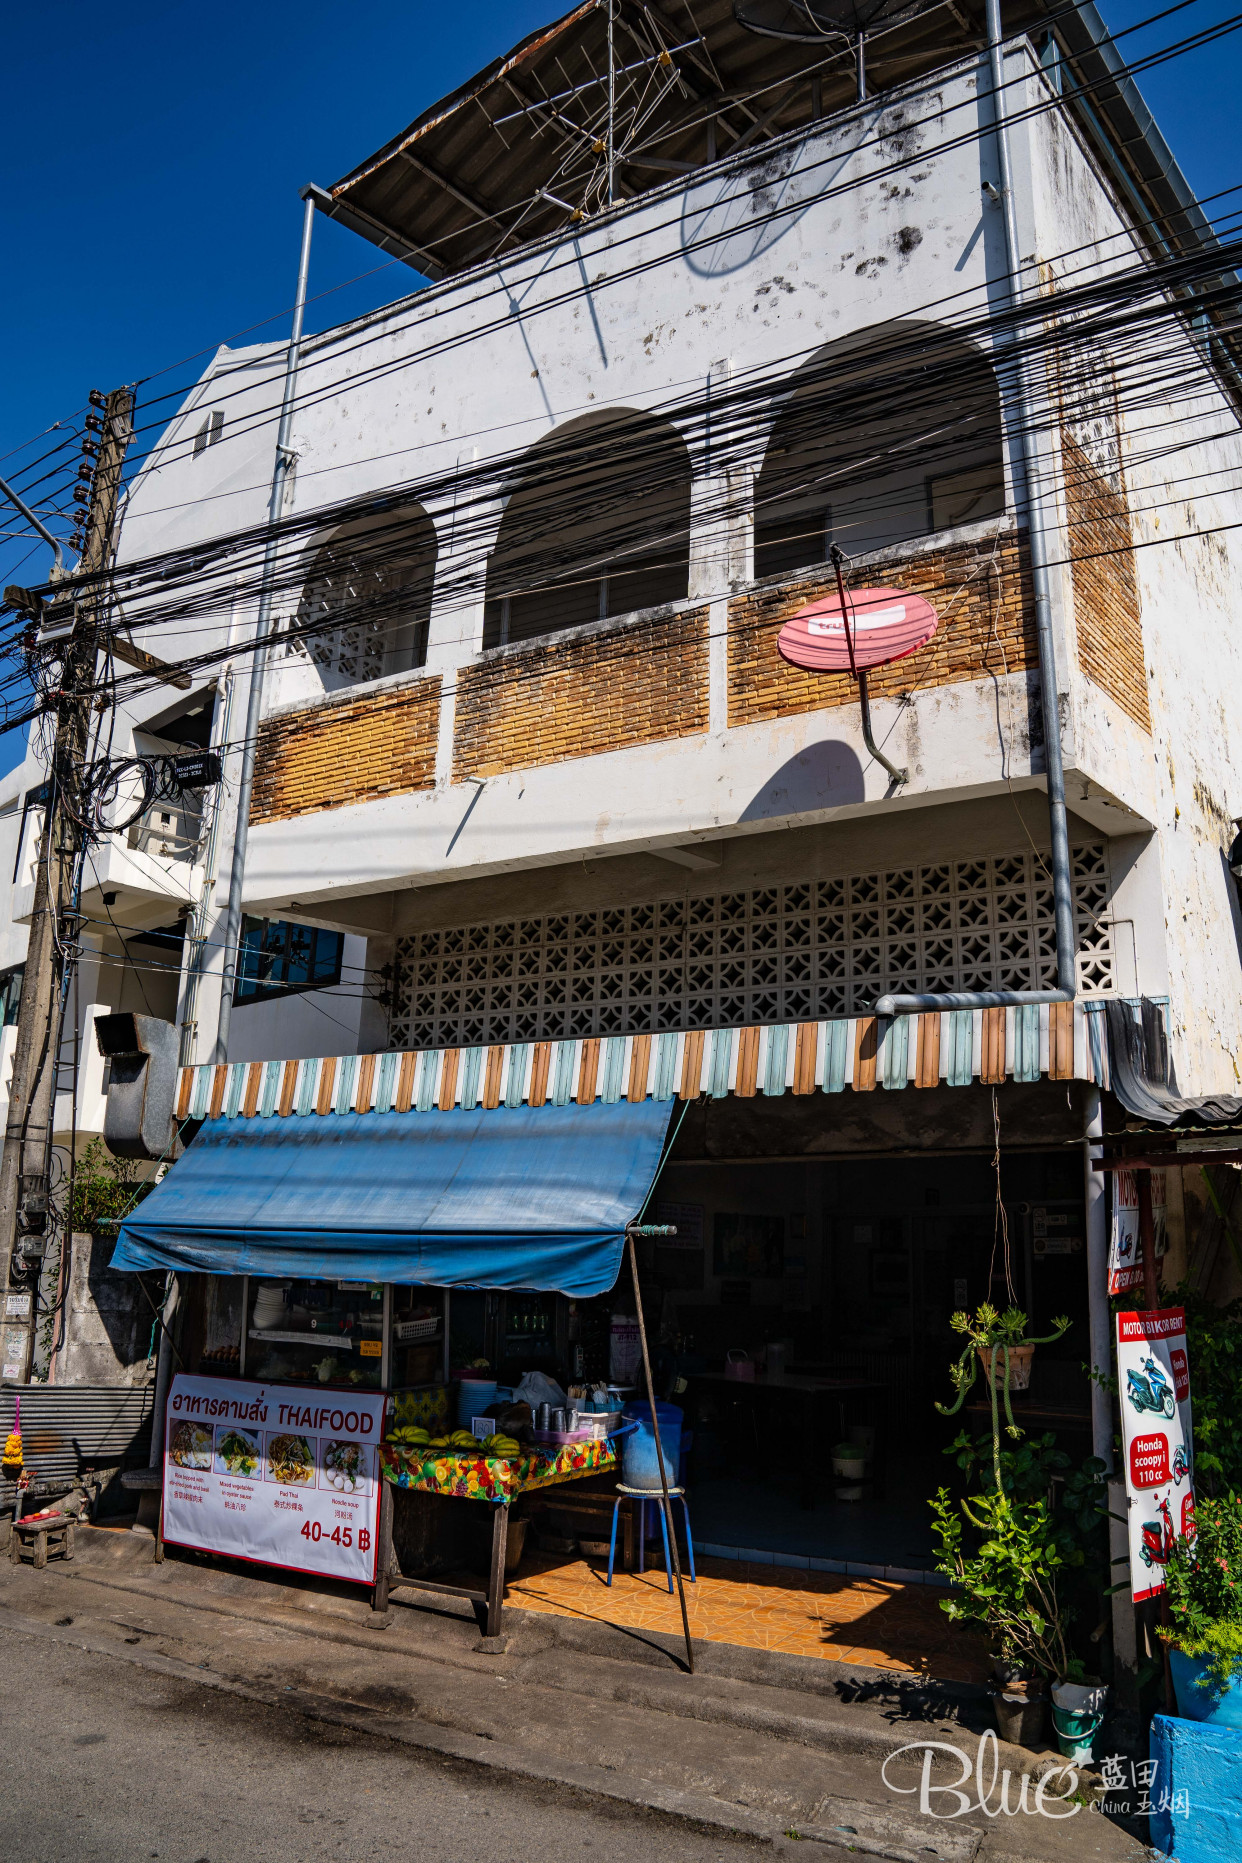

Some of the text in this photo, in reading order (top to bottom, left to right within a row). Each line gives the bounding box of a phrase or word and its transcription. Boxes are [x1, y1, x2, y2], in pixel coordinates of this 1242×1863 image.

[1122, 1322, 1146, 1335] MOTOR
[1146, 1320, 1164, 1334] BIK
[1170, 1316, 1182, 1330] RENT
[172, 1390, 374, 1434] อาหารตามสั่ง THAIFOOD
[1137, 1438, 1162, 1452] Honda
[1135, 1455, 1162, 1468] scoopy
[1139, 1470, 1162, 1483] 110 cc
[232, 1483, 254, 1492] vegetables
[300, 1520, 352, 1548] 40-45
